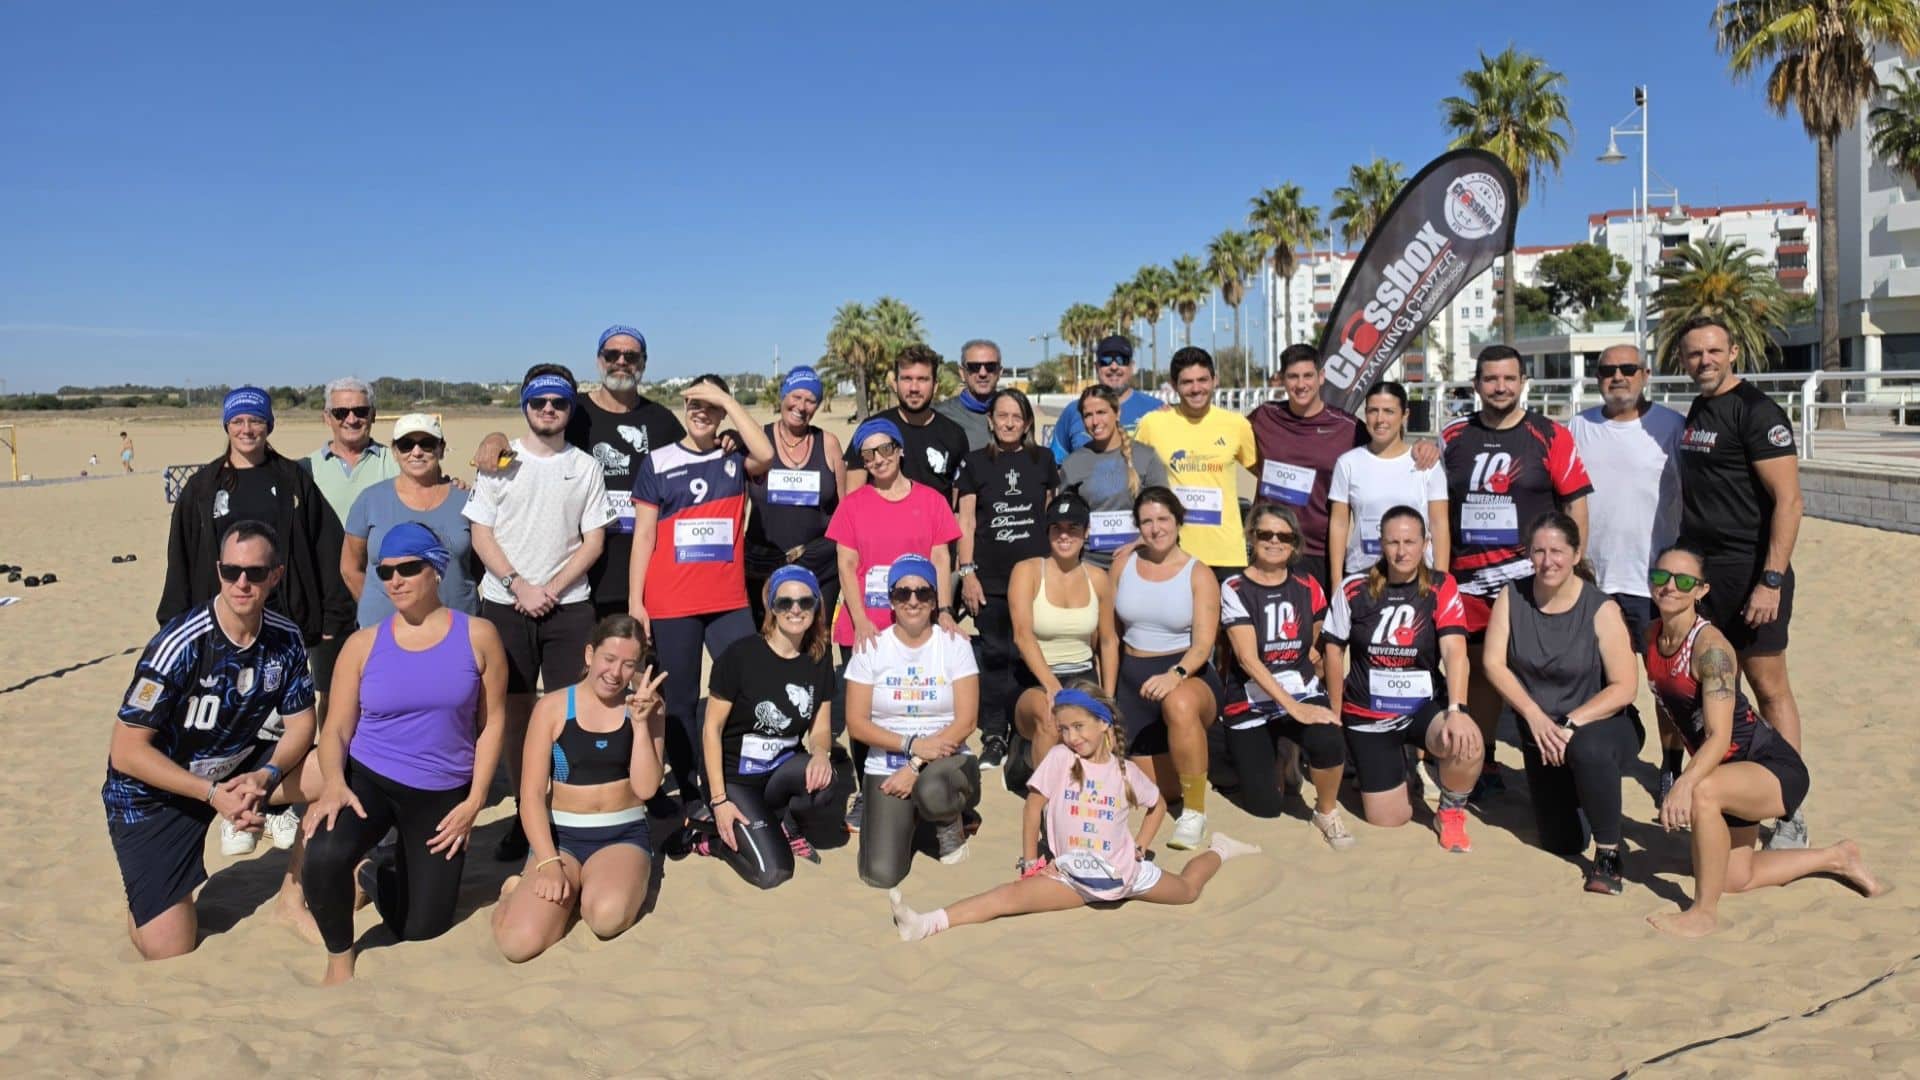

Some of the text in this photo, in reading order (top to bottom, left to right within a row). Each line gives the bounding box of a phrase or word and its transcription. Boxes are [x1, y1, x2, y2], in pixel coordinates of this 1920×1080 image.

[1352, 249, 1457, 393] TRAINING CENTER
[1178, 462, 1224, 473] WORLD RUN
[1469, 452, 1512, 493] 10
[1276, 470, 1297, 481] 000
[690, 477, 709, 505] 9
[1186, 494, 1207, 502] 000
[1474, 511, 1497, 521] 000
[1103, 519, 1123, 528] 000
[691, 527, 715, 536] 000
[1263, 601, 1296, 641] 10
[1370, 603, 1416, 647] 10
[1386, 679, 1412, 689] 000
[183, 695, 221, 731] 10
[1073, 859, 1100, 870] 000
